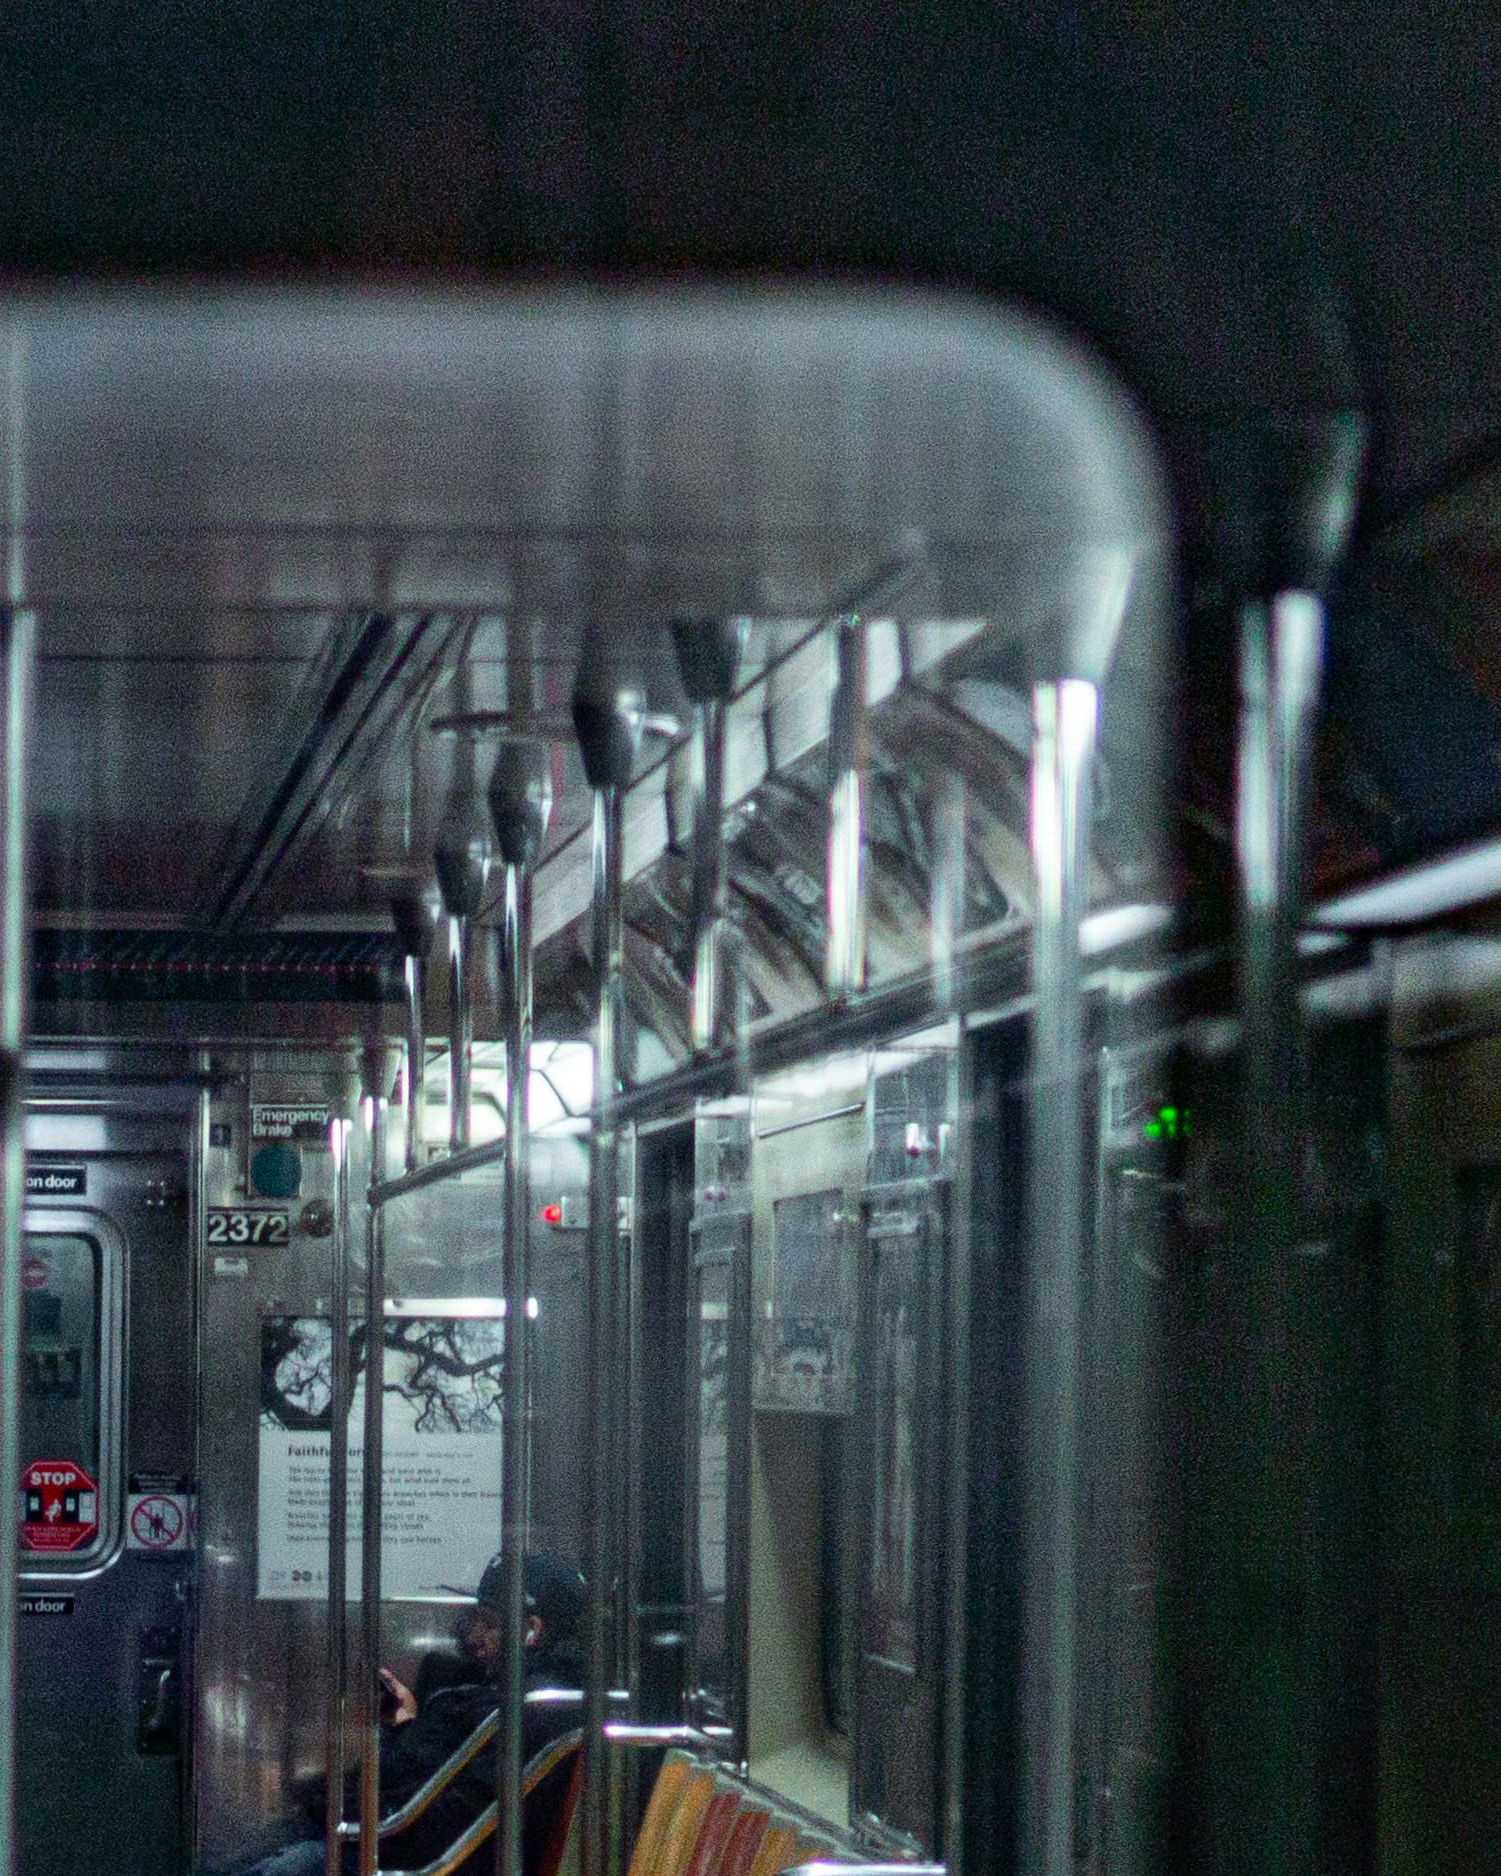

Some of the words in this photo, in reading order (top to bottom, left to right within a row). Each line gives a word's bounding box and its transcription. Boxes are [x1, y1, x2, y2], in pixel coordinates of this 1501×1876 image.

[252, 1107, 329, 1125] Emergency
[45, 1173, 77, 1188] door
[208, 1214, 288, 1242] 2372
[30, 1471, 77, 1486] STOP
[35, 1598, 66, 1612] door
